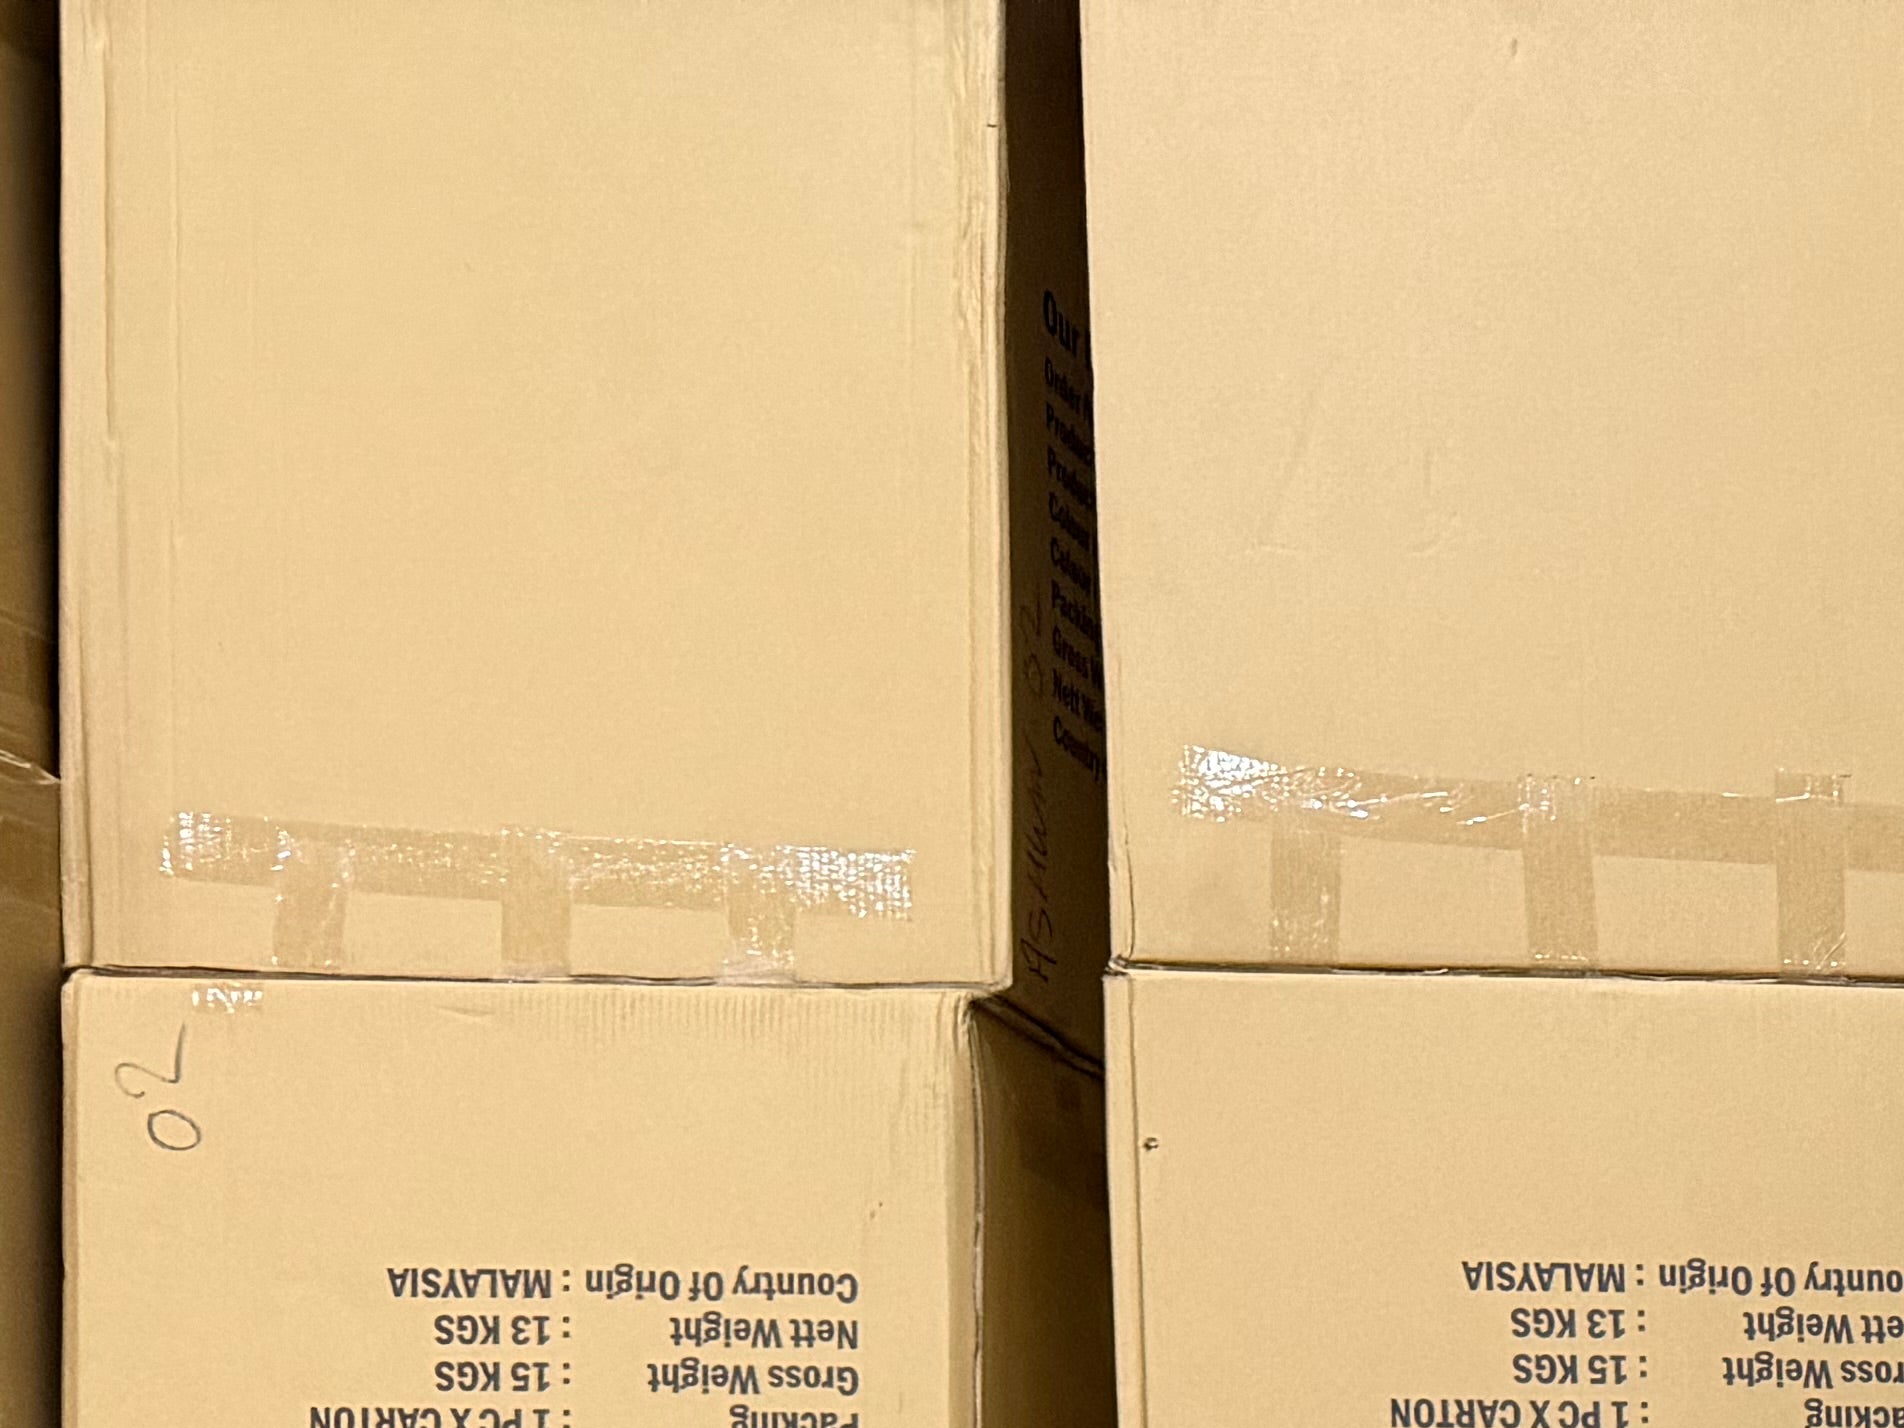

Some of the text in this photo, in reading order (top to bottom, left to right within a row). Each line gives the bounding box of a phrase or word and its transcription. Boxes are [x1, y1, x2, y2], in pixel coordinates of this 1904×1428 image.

[387, 1263, 858, 1304] Country Of Origin MALAYSIA
[1461, 1261, 1625, 1292] MALAYSIA
[1659, 1258, 1752, 1296] Origin
[1761, 1267, 1795, 1296] Of
[434, 1311, 858, 1349] Nett Weight 13 KGS
[1513, 1354, 1578, 1384] KGS
[1588, 1355, 1627, 1385] 15
[1722, 1351, 1833, 1389] Weight
